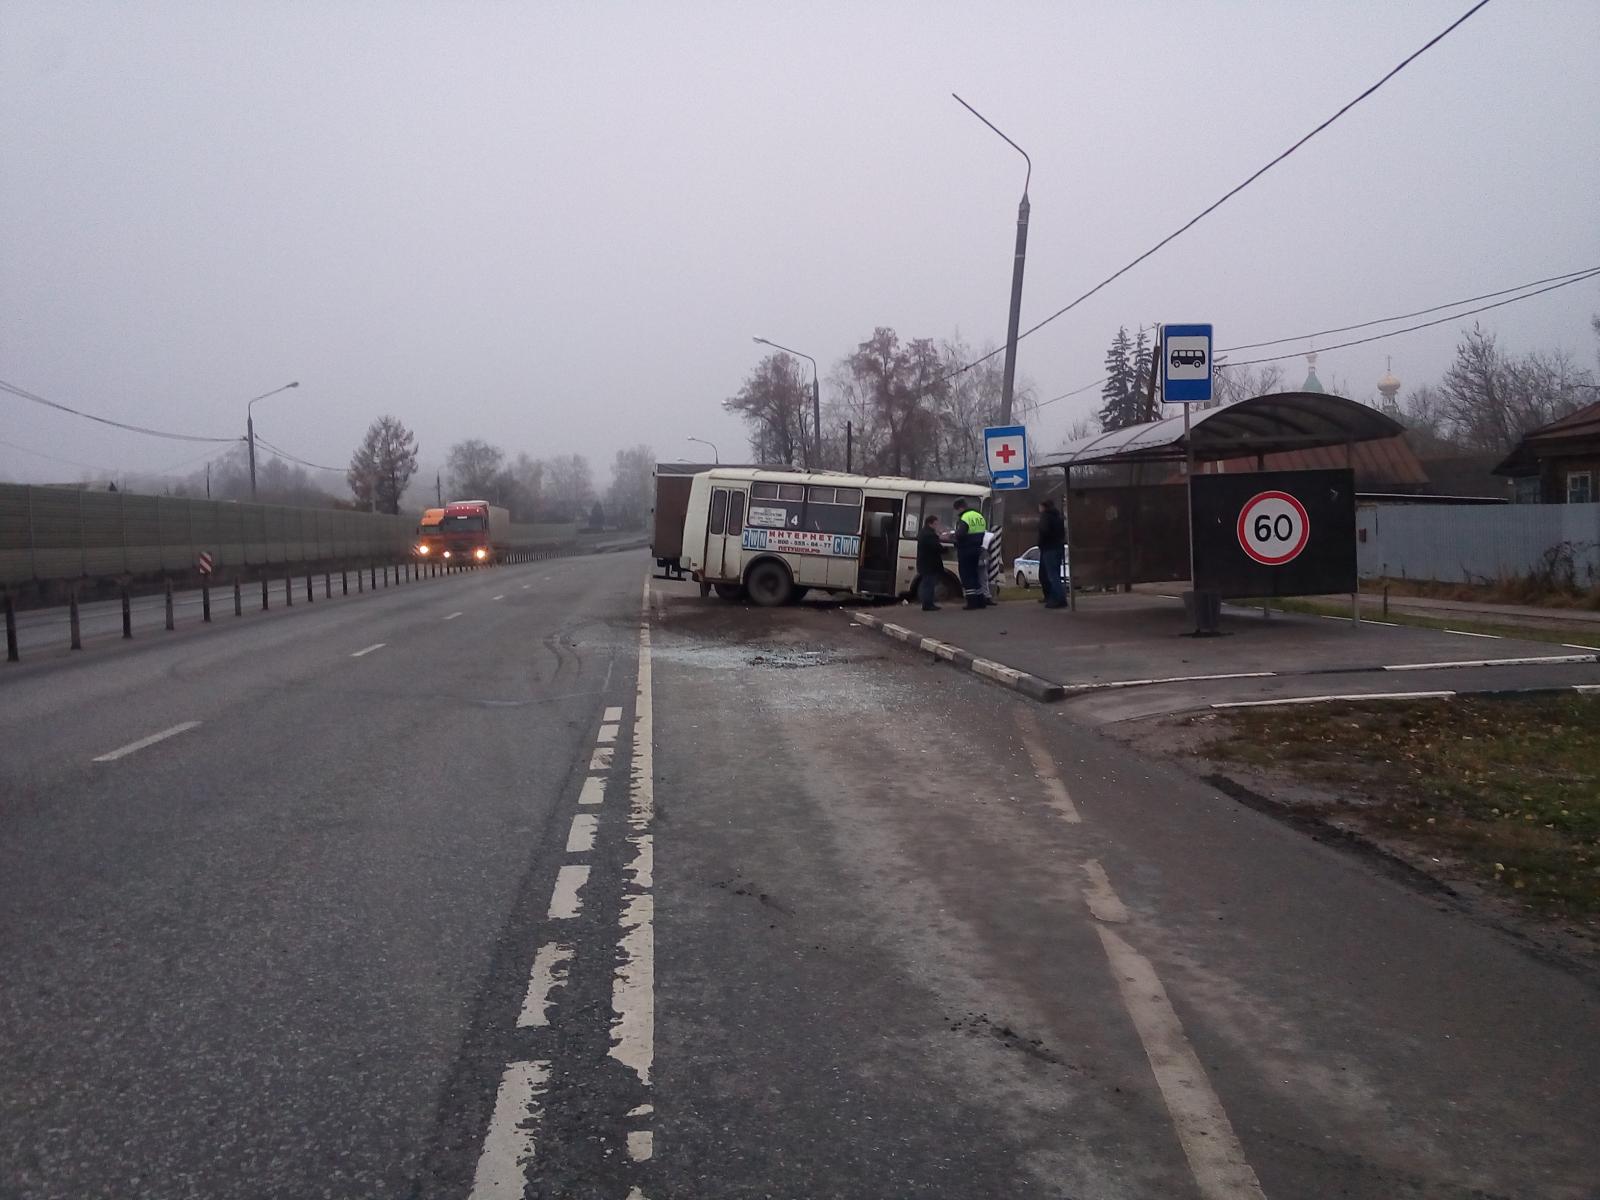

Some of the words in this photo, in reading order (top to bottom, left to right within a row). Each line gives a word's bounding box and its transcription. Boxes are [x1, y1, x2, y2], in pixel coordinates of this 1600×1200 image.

[791, 515, 798, 526] 4
[1254, 514, 1293, 542] 60
[769, 530, 833, 542] ИНТЕРНЕТ
